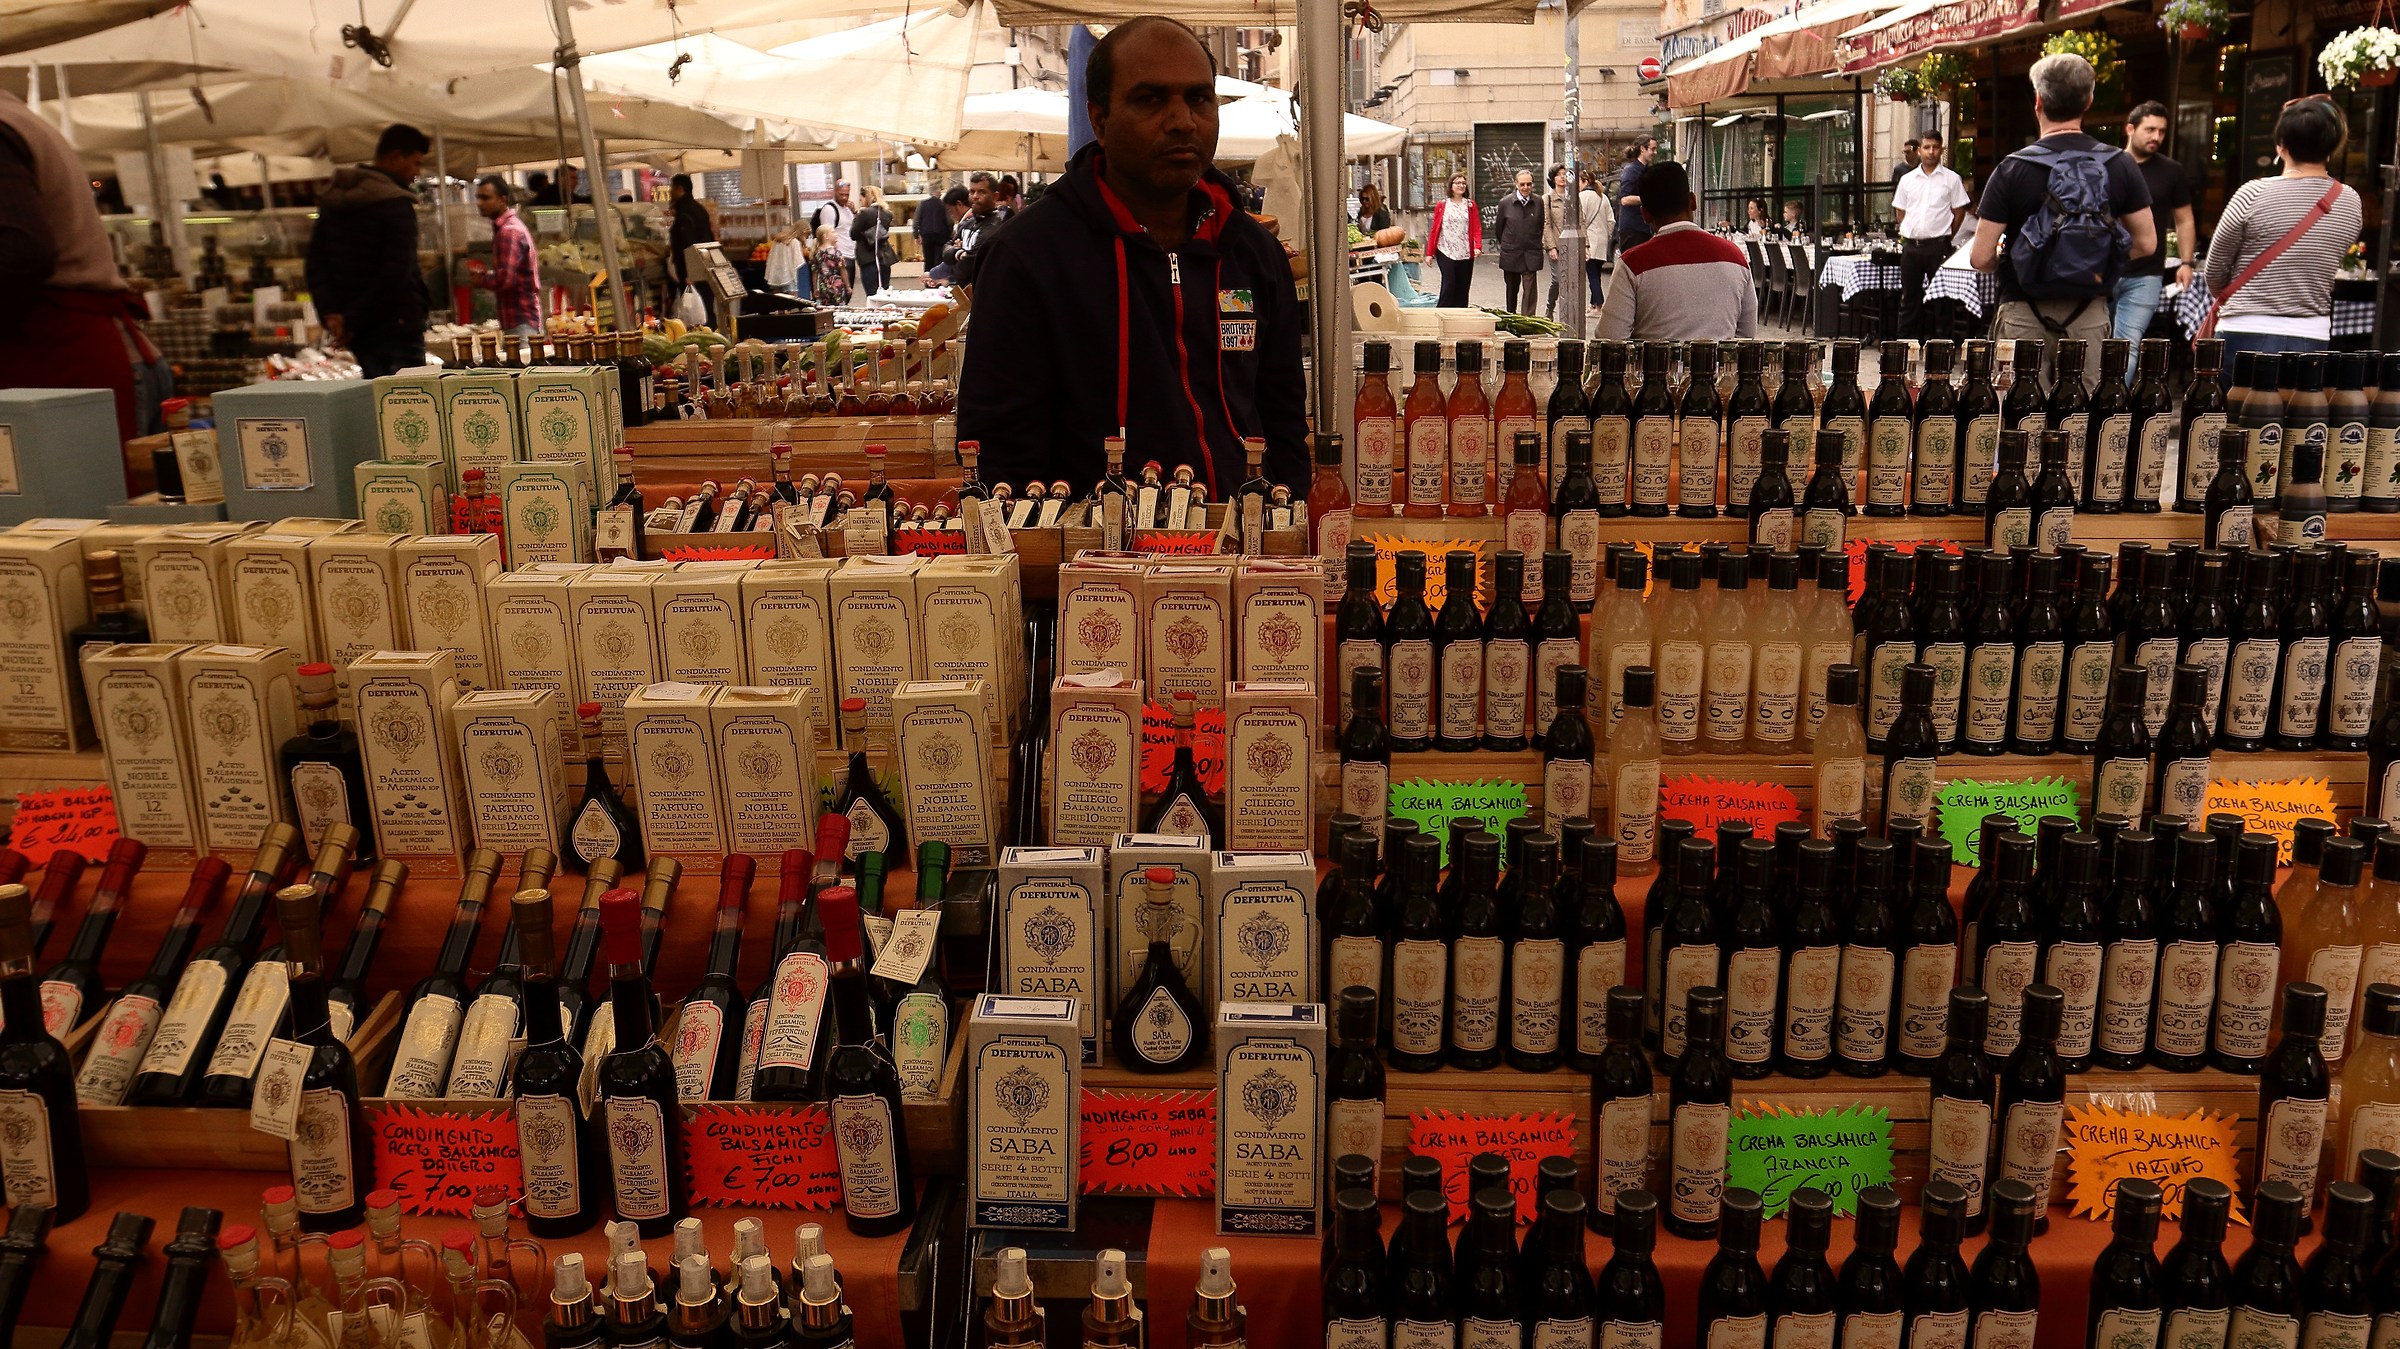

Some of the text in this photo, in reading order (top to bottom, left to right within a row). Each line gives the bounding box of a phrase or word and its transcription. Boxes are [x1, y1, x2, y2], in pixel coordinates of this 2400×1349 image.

[388, 398, 429, 406] DEFRUTUM
[458, 398, 501, 406] DEFRUTUM
[535, 395, 579, 403] DEFRUTUM
[371, 486, 415, 494] DEFRUTUM
[516, 484, 560, 492] DEFRUTUM
[517, 542, 567, 550] CONDIMENTO
[908, 541, 966, 552] CONDIMEN
[1136, 543, 1214, 554] CONDIMENT
[529, 554, 558, 563] MELE
[243, 567, 289, 575] DEFRUTUM
[327, 567, 375, 575] DEFRUTUM
[415, 568, 464, 577] DEFRUTUM
[933, 598, 982, 606] DEFRUTUM
[1075, 595, 1126, 604] DEFRUTUM
[1254, 599, 1307, 608] DEFRUTUM
[587, 606, 636, 615] DEFRUTUM
[761, 602, 812, 611] DEFRUTUM
[847, 603, 897, 611] DEFRUTUM
[1161, 603, 1212, 612] DEFRUTUM
[1159, 666, 1216, 674] CONDIMENTO
[107, 681, 155, 690] DEFRUTUM
[197, 681, 246, 690] DEFRUTUM
[857, 678, 899, 687] NOBILE
[1163, 679, 1212, 688] CILIEGIO
[367, 688, 418, 697] DEFRUTUM
[911, 717, 964, 726] DEFRUTUM
[1068, 714, 1122, 724] DEFRUTUM
[1243, 719, 1298, 728] DEFRUTUM
[472, 728, 523, 737] DEFRUTUM
[643, 727, 694, 736] DEFRUTUM
[730, 727, 781, 736] DEFRUTUM
[217, 761, 246, 770] ACETO
[127, 772, 170, 781] NOBILE
[206, 768, 260, 777] BALSAMICO
[391, 768, 421, 776] ACETO
[380, 775, 435, 783] BALSAMICO
[122, 781, 177, 790] BALSAMICO
[388, 783, 427, 791] MODENA
[1063, 781, 1124, 790] CONDIMENTO
[63, 794, 114, 808] BALSAM
[923, 795, 968, 804] NOBILE
[1067, 794, 1118, 804] CILIEGIO
[1244, 799, 1295, 808] CILIEGIO
[1401, 796, 1522, 811] CREMA BALSAMICA
[1669, 792, 1788, 811] CREMA BALSAMICA
[1947, 793, 2068, 810] CREMA BALSAMICO
[146, 800, 162, 813] 12
[483, 804, 534, 813] TARTUFO
[744, 803, 789, 812] NOBILE
[917, 804, 977, 813] BALSAMICO
[1062, 803, 1124, 814] BALSAMICO
[2207, 797, 2324, 814] CREMA BALSAMICA
[738, 812, 796, 820] BALSAMICO
[1239, 807, 1301, 817] BALSAMICO
[482, 813, 540, 821] BALSAMICO
[1059, 812, 1127, 824] SERIE 10 BOTTI
[2246, 811, 2296, 832] BIANC
[481, 820, 545, 831] SERIE 12 BOTTI
[1079, 836, 1105, 845] ITALIA
[1019, 890, 1080, 900] DEFRUTUM
[1233, 895, 1295, 905] DEFRUTUM
[1020, 977, 1083, 995] SABA
[1233, 982, 1296, 998] SABA
[1152, 1031, 1172, 1040] SABA
[2224, 1040, 2262, 1050] TRUFFLE
[991, 1050, 1056, 1060] DEFRUTUM
[1239, 1052, 1303, 1062] DEFRUTUM
[1081, 1108, 1206, 1125] NDIMENTO SABA
[382, 1122, 494, 1143] CONDIMENTO
[706, 1121, 824, 1138] CONDIMENTO
[986, 1126, 1059, 1135] CONDIMENTO
[1233, 1131, 1306, 1140] CONDIMENTO
[1419, 1129, 1566, 1149] CREMA BALSAMICA
[2080, 1125, 2221, 1151] CREMA BALSAMICA
[720, 1136, 822, 1151] BALSAMICO
[1739, 1132, 1878, 1151] CREMA BALSAMICA
[388, 1140, 519, 1159] ACETO BALSAMICO
[989, 1138, 1055, 1156] SABA
[1236, 1143, 1304, 1160] SABA
[1105, 1138, 1158, 1168] 8,00
[748, 1152, 803, 1166] FICHI
[981, 1162, 1063, 1175] SERIE 4 BOTTI
[617, 1178, 659, 1187] PEPERONCINO
[723, 1166, 747, 1190] €
[752, 1166, 800, 1194] 7,00
[847, 1176, 891, 1185] PEPERONCINO
[424, 1173, 471, 1201] 7,00
[1007, 1190, 1038, 1199] ITALIA
[1253, 1196, 1285, 1205] ITALIA
